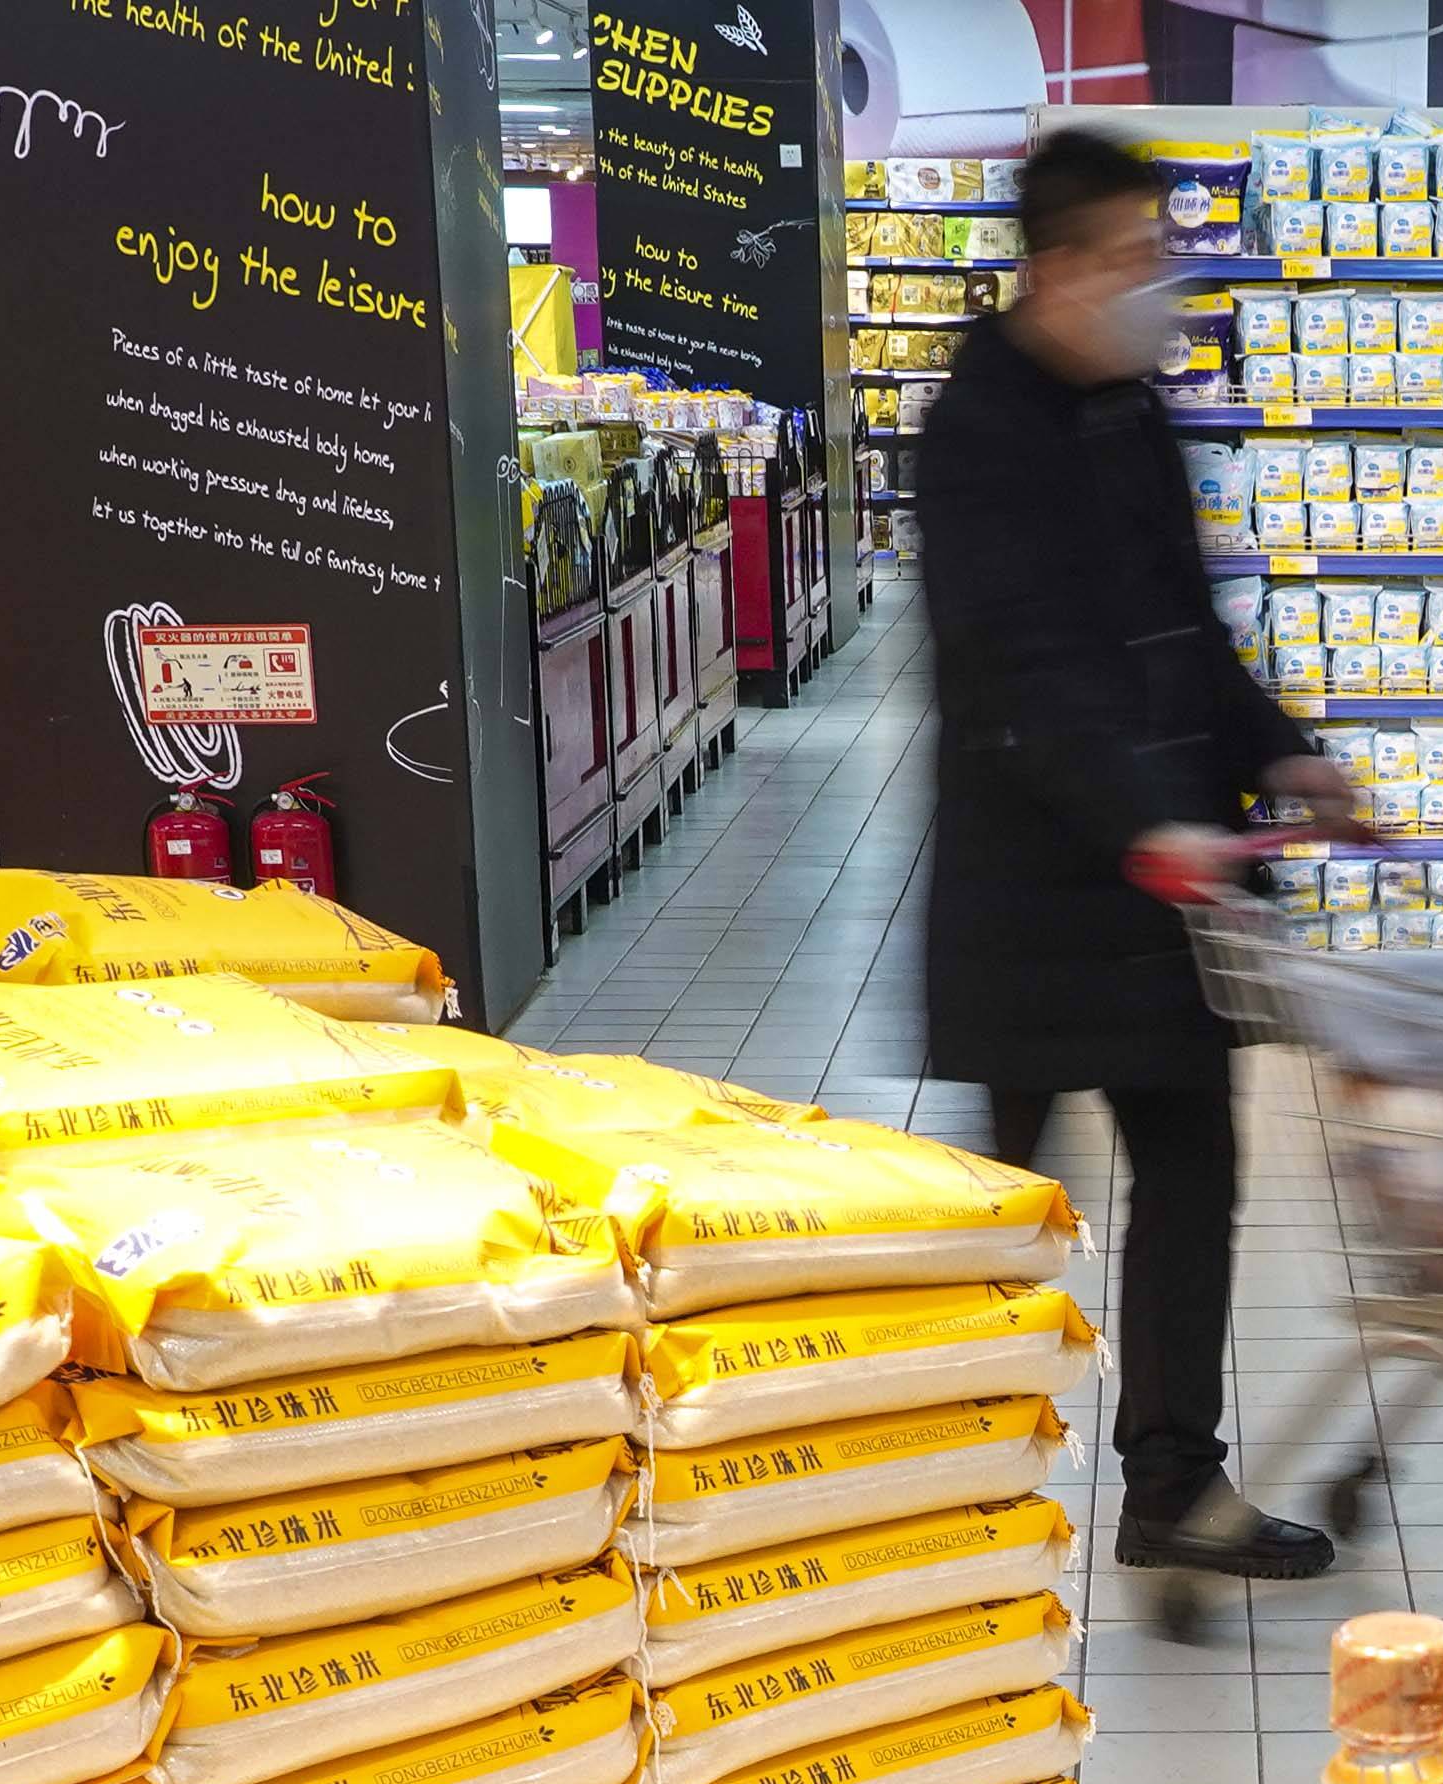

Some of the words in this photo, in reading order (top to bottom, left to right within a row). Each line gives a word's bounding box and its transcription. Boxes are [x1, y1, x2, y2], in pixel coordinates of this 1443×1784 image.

[218, 18, 247, 51] of
[261, 25, 304, 65] the
[316, 37, 394, 89] United
[596, 59, 774, 137] SUPPLIES
[608, 127, 629, 147] the
[634, 132, 675, 170] beauty
[679, 146, 695, 163] of
[698, 151, 719, 170] the
[261, 173, 336, 230] how
[354, 201, 396, 247] to
[618, 164, 634, 181] of
[637, 168, 658, 187] the
[662, 174, 699, 198] United
[703, 184, 747, 209] States
[116, 222, 220, 311] enjoy
[240, 246, 300, 297] the
[318, 260, 427, 328] leisure
[635, 235, 671, 263] how
[677, 248, 698, 270] to
[625, 267, 654, 294] the
[660, 272, 713, 309] leisure
[722, 293, 759, 320] time
[112, 328, 160, 361] Pieces
[165, 346, 184, 366] of
[188, 356, 199, 370] a
[203, 352, 239, 380] little
[245, 364, 288, 391] taste
[295, 375, 312, 395] of
[317, 378, 354, 406] home
[359, 388, 382, 412] let
[383, 401, 419, 430] your
[106, 388, 144, 415] when
[149, 392, 203, 434] dragged
[210, 408, 231, 434] his
[236, 419, 310, 451] exhausted
[316, 433, 348, 474] body
[353, 442, 395, 475] home,
[99, 445, 137, 470] when
[143, 459, 200, 493] working
[206, 468, 270, 499] pressure
[275, 478, 307, 516] drag
[312, 489, 337, 515] and
[341, 495, 395, 530] lifeless,
[92, 496, 113, 520] let
[118, 509, 136, 526] us
[142, 510, 208, 543] together
[213, 524, 244, 549] into
[249, 529, 275, 557] the
[281, 538, 301, 562] full
[305, 549, 323, 566] of
[327, 548, 386, 594] fantasy
[390, 564, 428, 591] home
[360, 1362, 532, 1399] DONGBEIZHENZHUMI
[712, 1329, 850, 1373] 东北珍珠米
[228, 1650, 380, 1711] 东北珍珠米
[705, 1661, 835, 1719] 东北珍珠米
